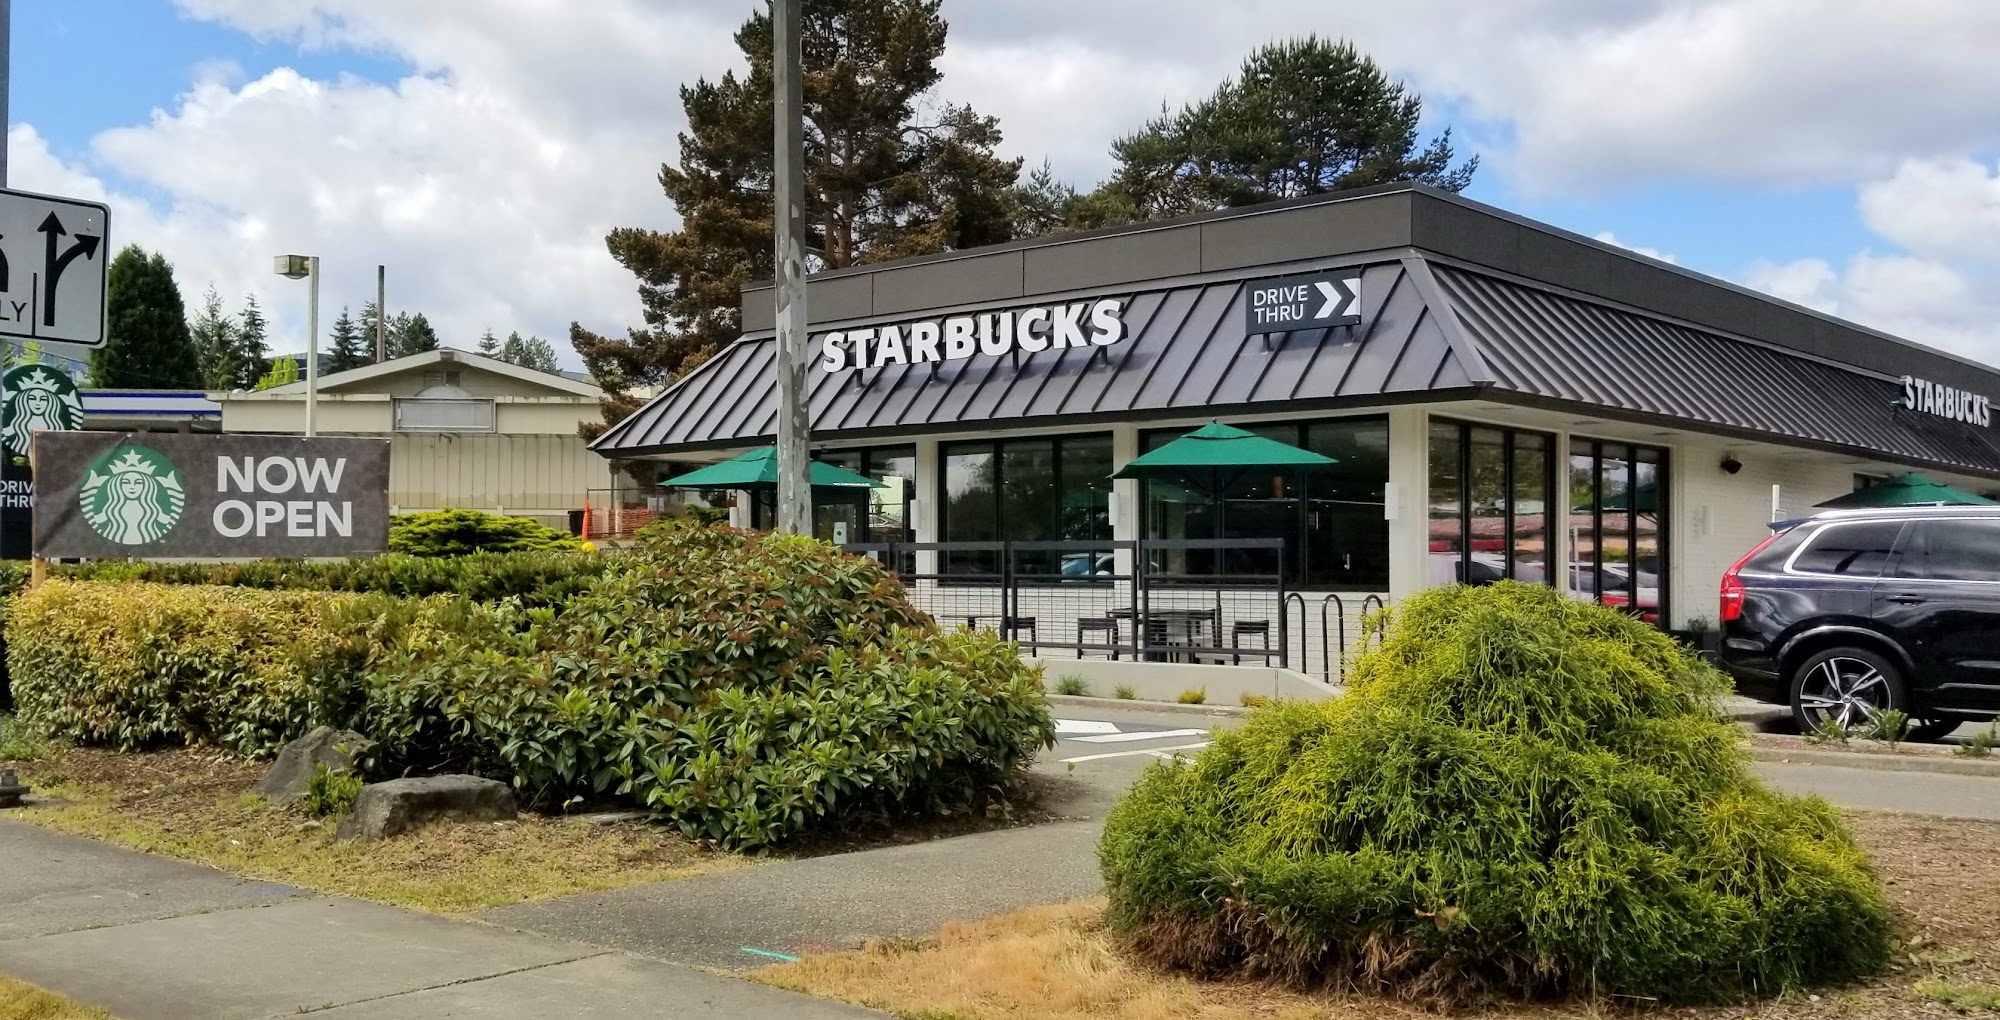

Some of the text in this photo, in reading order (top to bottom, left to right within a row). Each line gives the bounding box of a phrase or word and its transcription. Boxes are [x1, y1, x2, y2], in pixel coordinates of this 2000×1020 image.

[1253, 284, 1309, 307] DRIVE
[1253, 303, 1304, 324] THRU
[821, 299, 1124, 373] STARBUCKS
[1904, 375, 1989, 428] STARBUCKS
[0, 480, 34, 494] DRIV
[217, 455, 347, 494] NOW
[212, 499, 352, 538] OPEN
